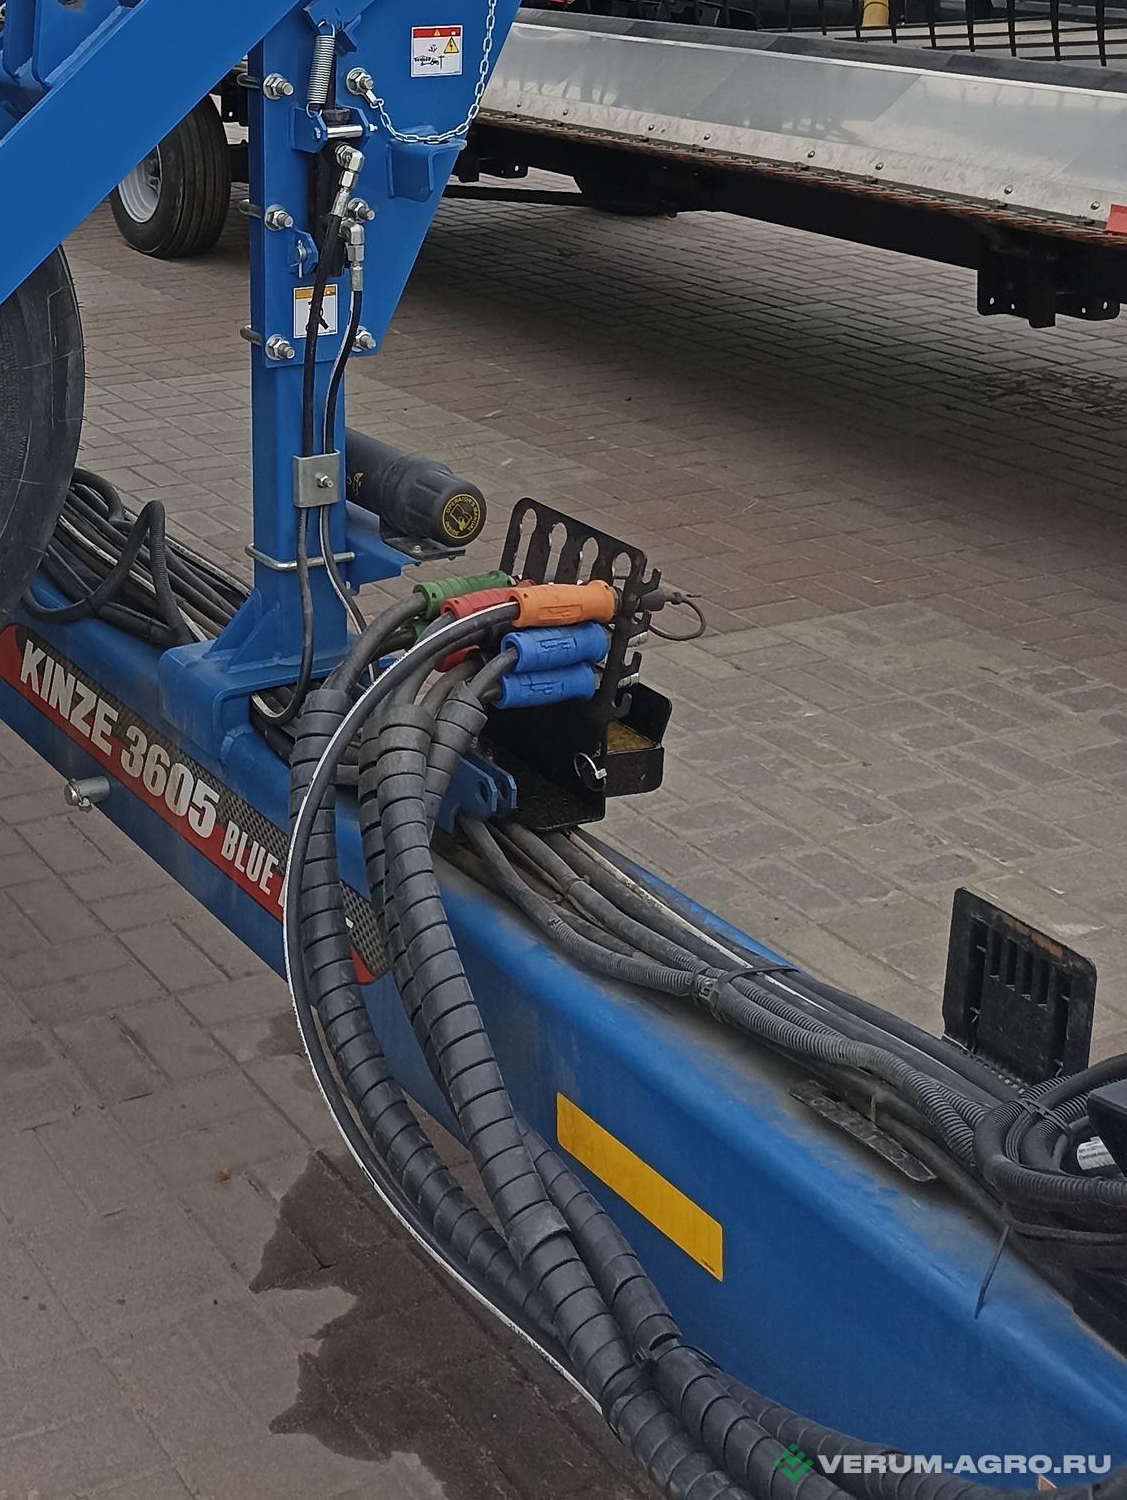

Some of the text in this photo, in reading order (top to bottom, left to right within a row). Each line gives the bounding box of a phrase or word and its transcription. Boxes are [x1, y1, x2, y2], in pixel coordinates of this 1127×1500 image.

[20, 638, 279, 896] KINZE 3605 BLUE
